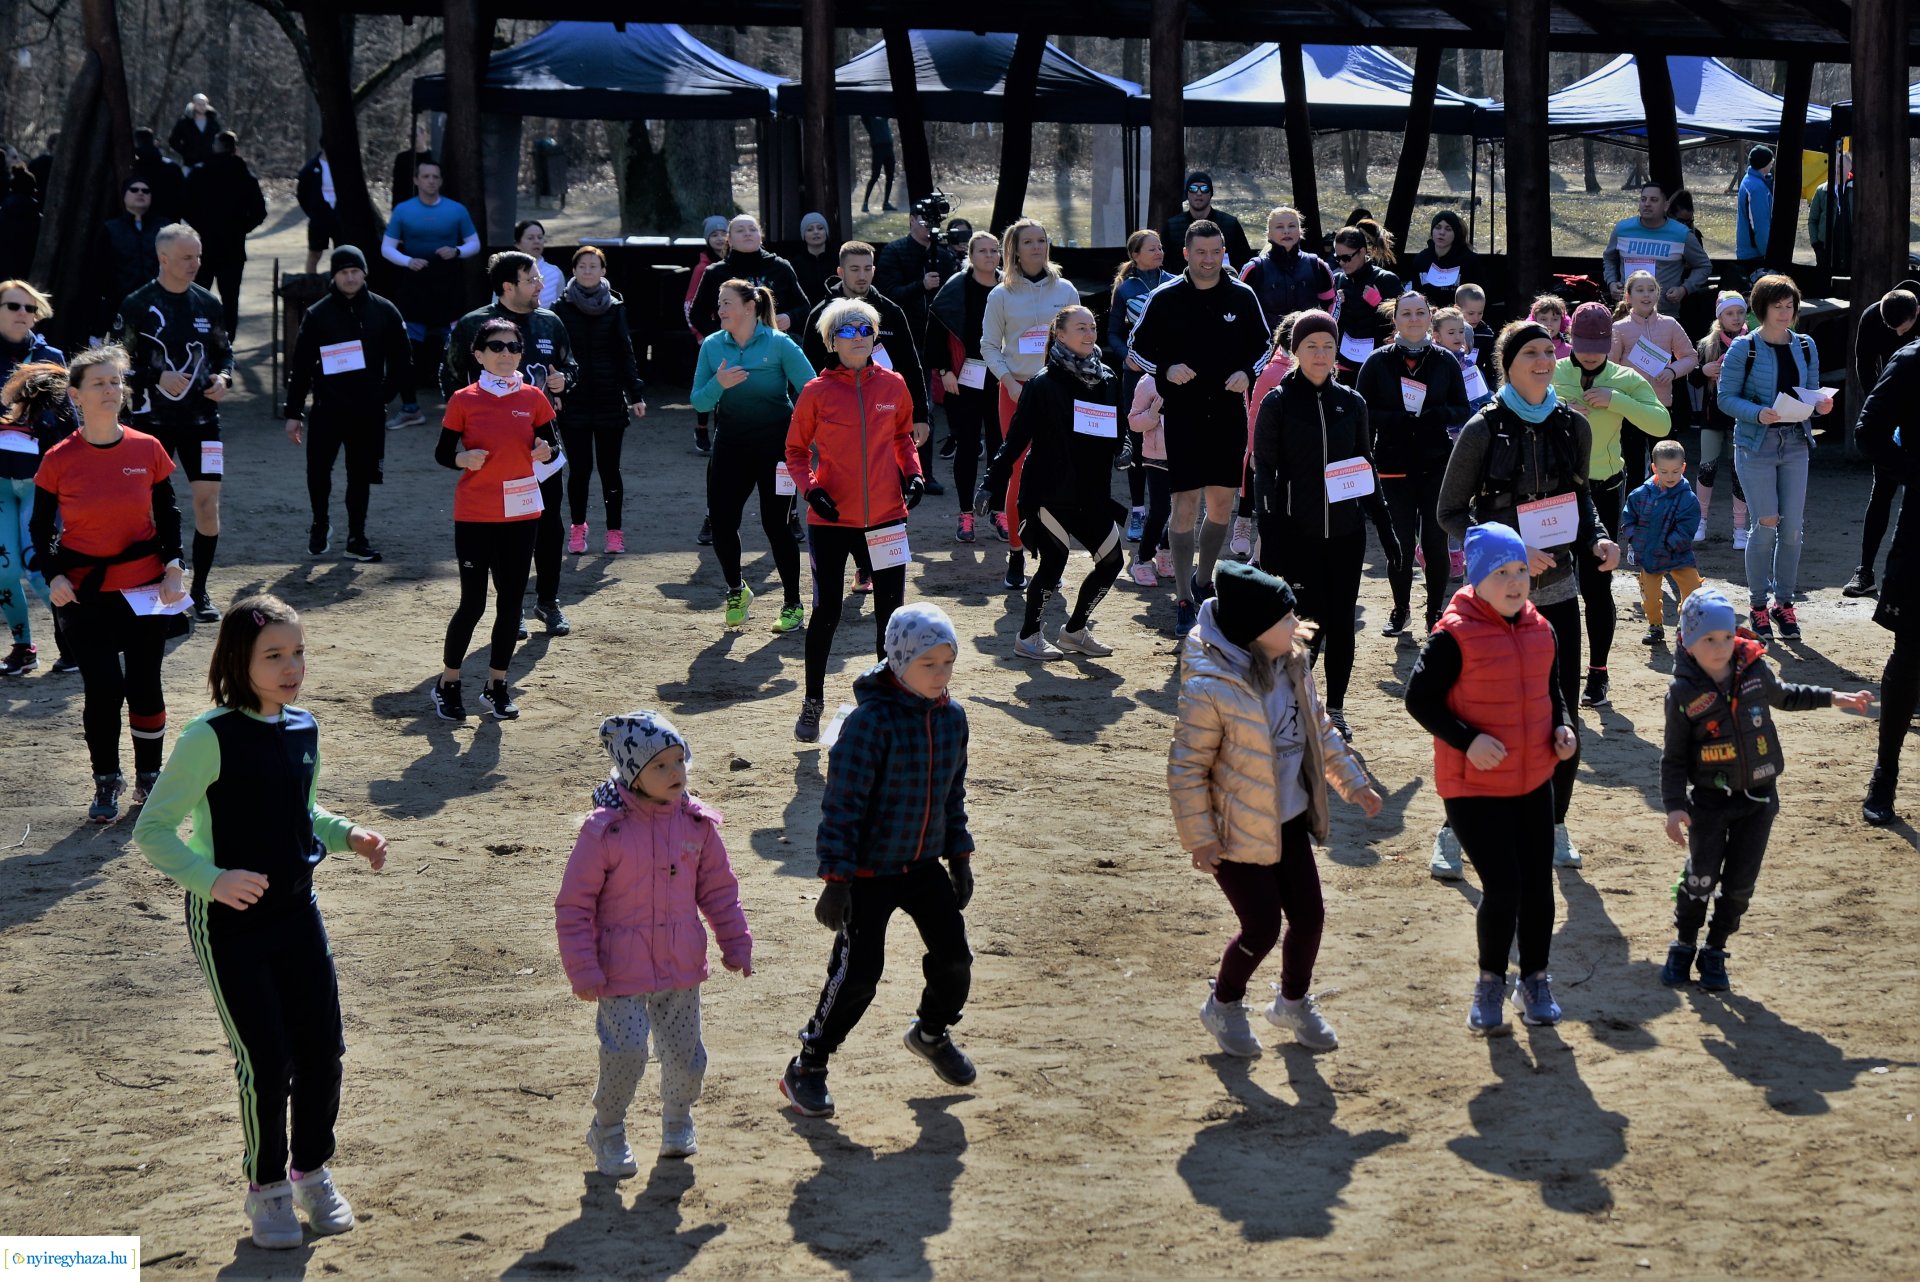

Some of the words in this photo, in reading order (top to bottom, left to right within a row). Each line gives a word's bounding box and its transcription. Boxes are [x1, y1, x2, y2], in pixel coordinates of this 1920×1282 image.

[1628, 241, 1671, 257] PUMA
[1404, 392, 1416, 401] 415
[783, 480, 793, 488] 304
[1342, 480, 1355, 489] 110
[522, 497, 534, 506] 204
[1541, 516, 1558, 527] 413
[889, 547, 903, 556] 402
[1701, 747, 1737, 762] HULK
